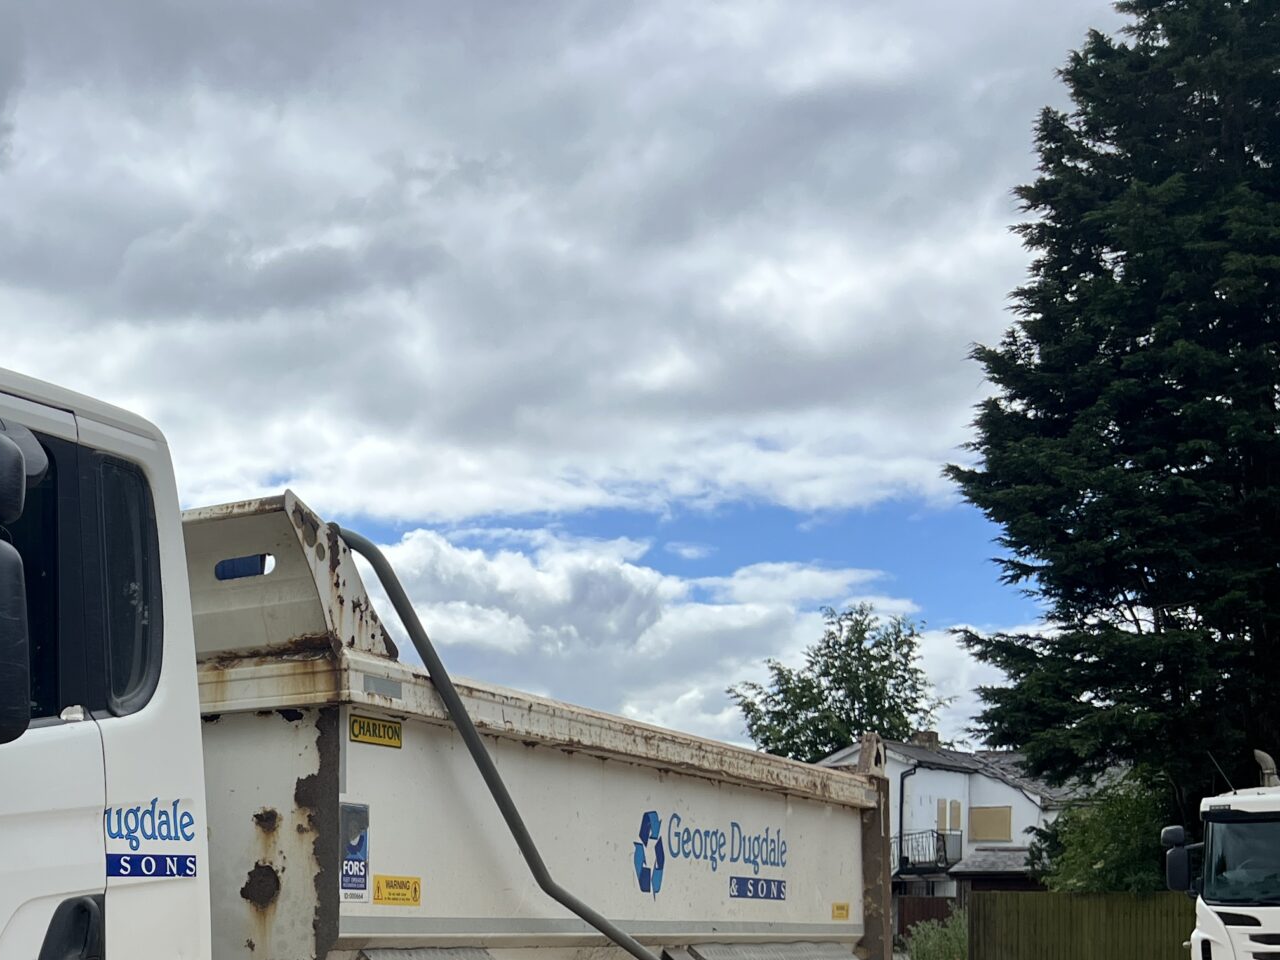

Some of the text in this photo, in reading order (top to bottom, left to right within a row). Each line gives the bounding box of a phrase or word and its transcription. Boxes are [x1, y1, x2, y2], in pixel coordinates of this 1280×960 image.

[351, 719, 400, 741] CHARLTON
[667, 812, 787, 875] George Dugdale
[119, 856, 196, 875] SONS
[343, 860, 365, 876] FORS
[385, 880, 410, 891] WARNING
[729, 878, 786, 899] & SONS
